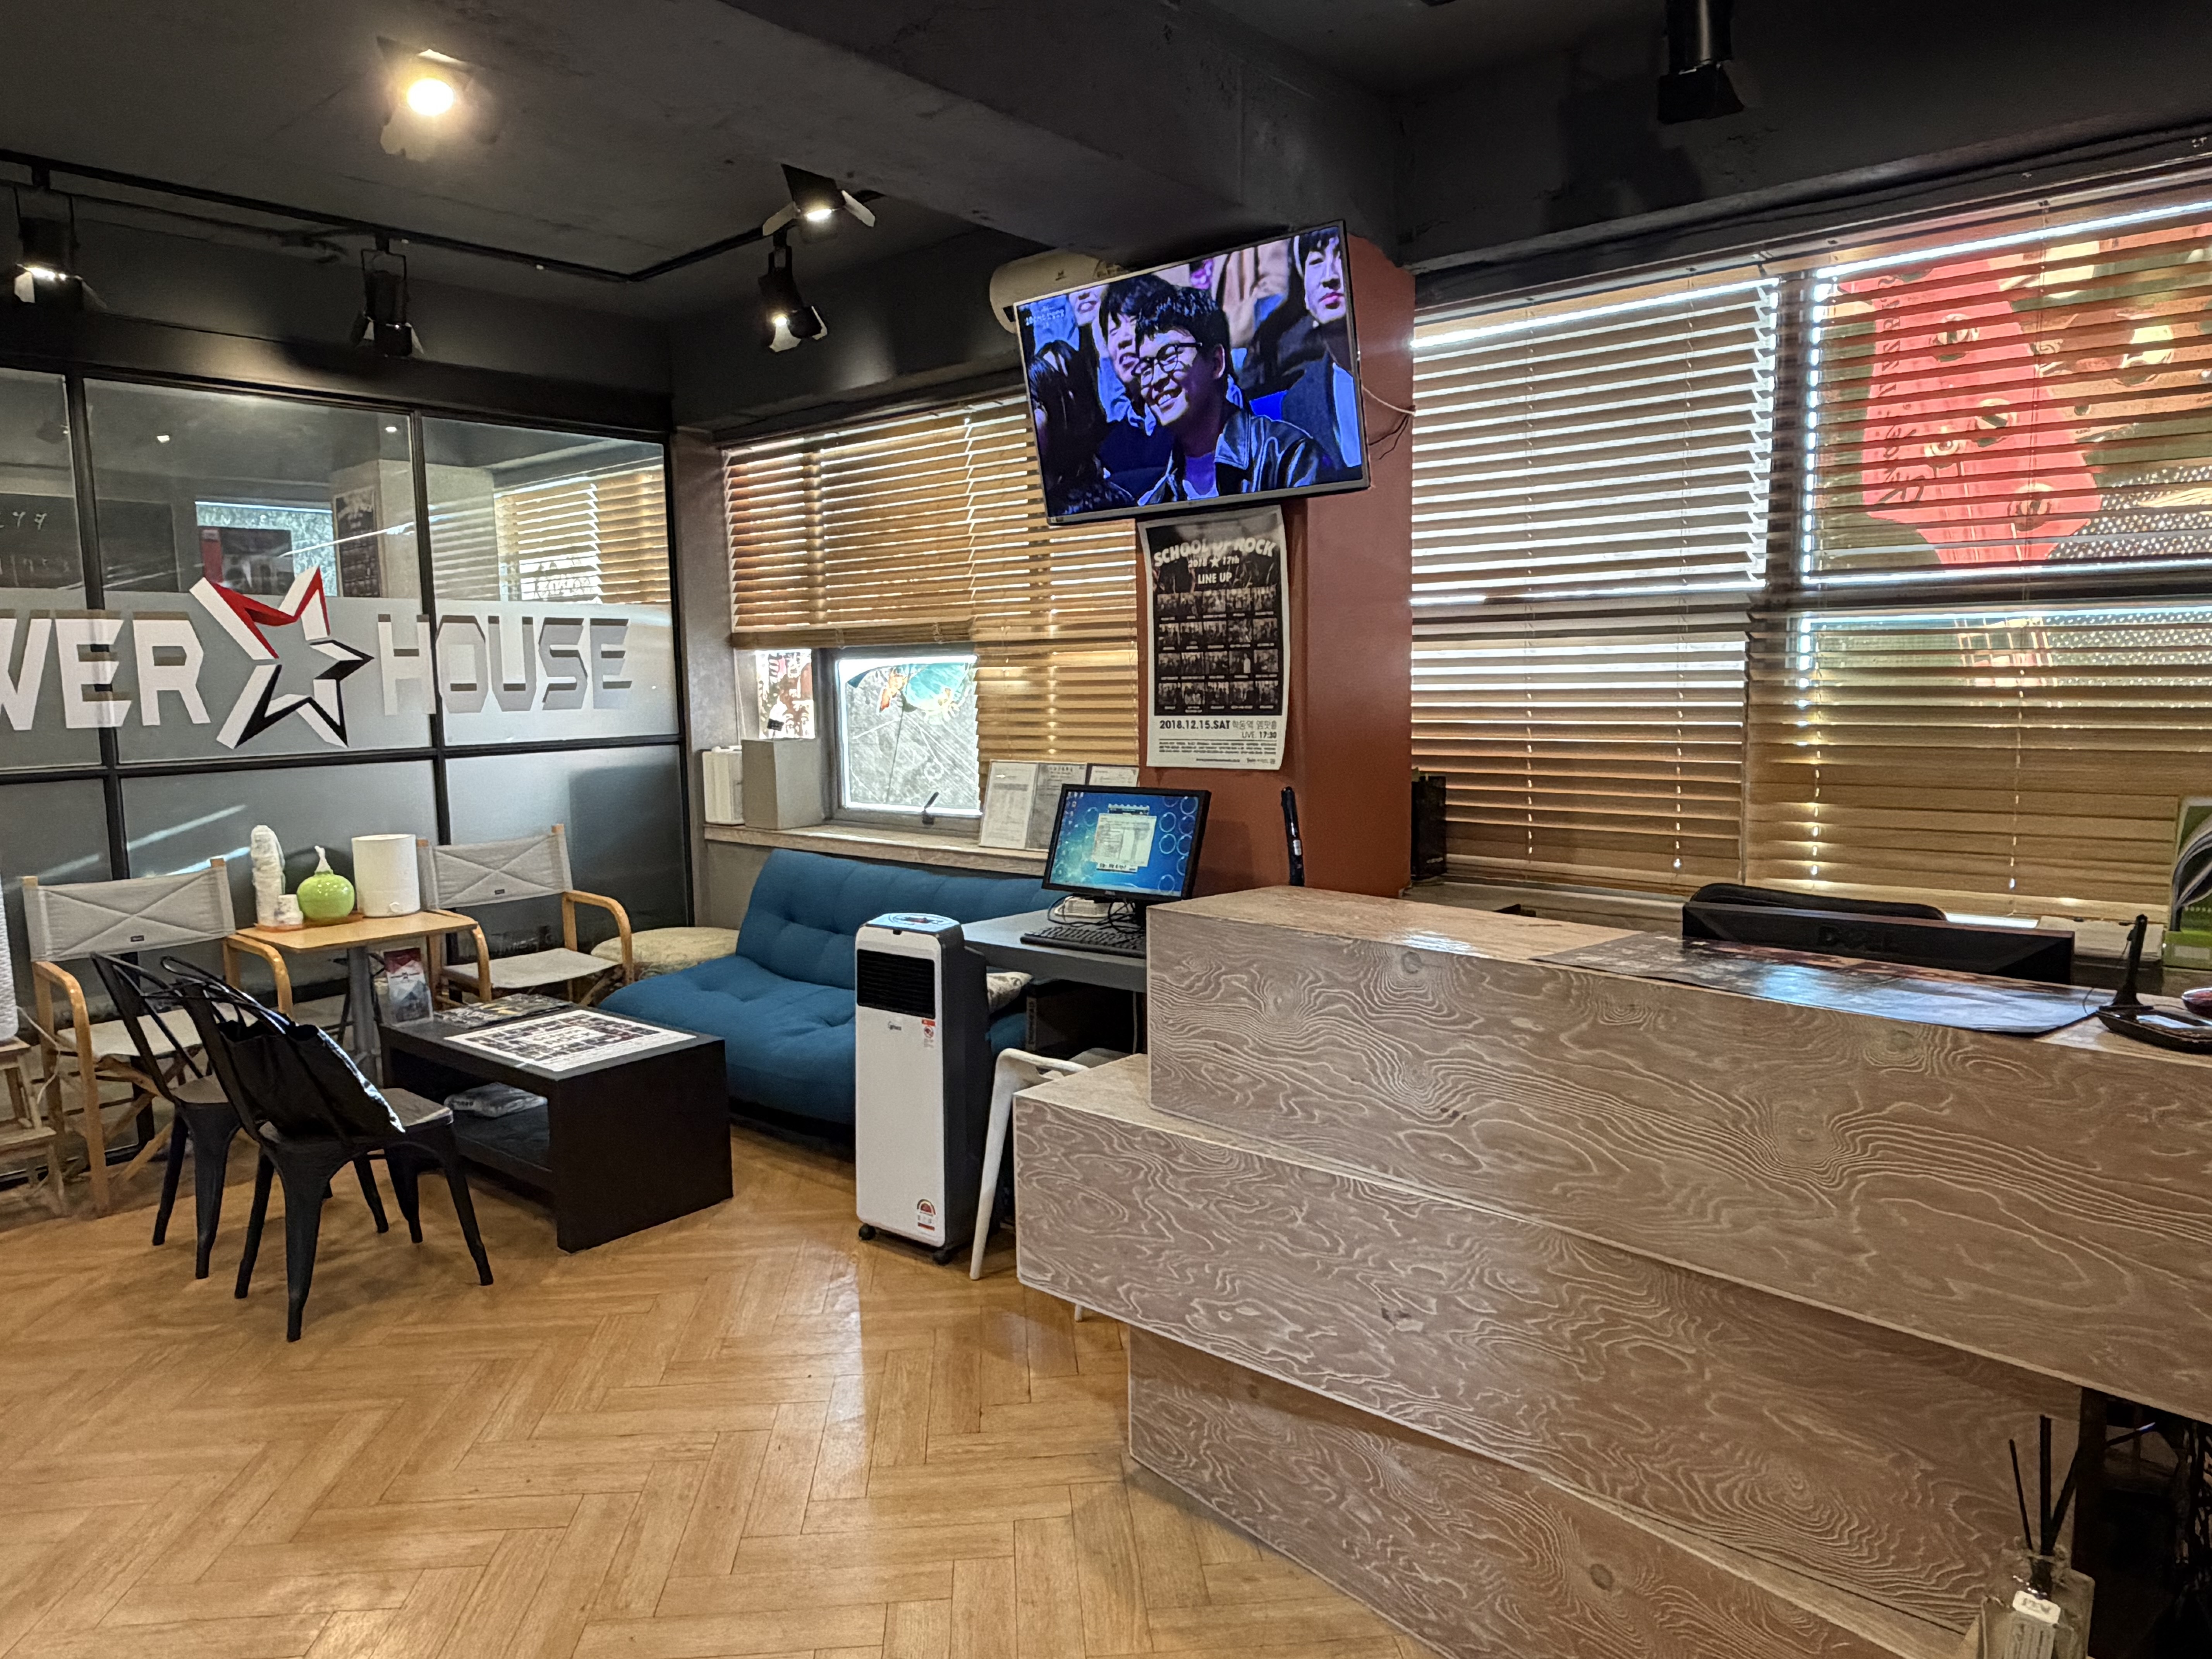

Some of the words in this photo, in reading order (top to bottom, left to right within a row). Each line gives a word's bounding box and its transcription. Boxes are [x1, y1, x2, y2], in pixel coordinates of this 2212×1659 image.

[1154, 539, 1209, 567] SCHOOL
[1233, 537, 1277, 558] ROCK
[1197, 573, 1217, 584] LINE
[1219, 572, 1232, 582] UP
[377, 613, 632, 716] HOUSE
[1159, 720, 1231, 730] 2018.12.15.SAT
